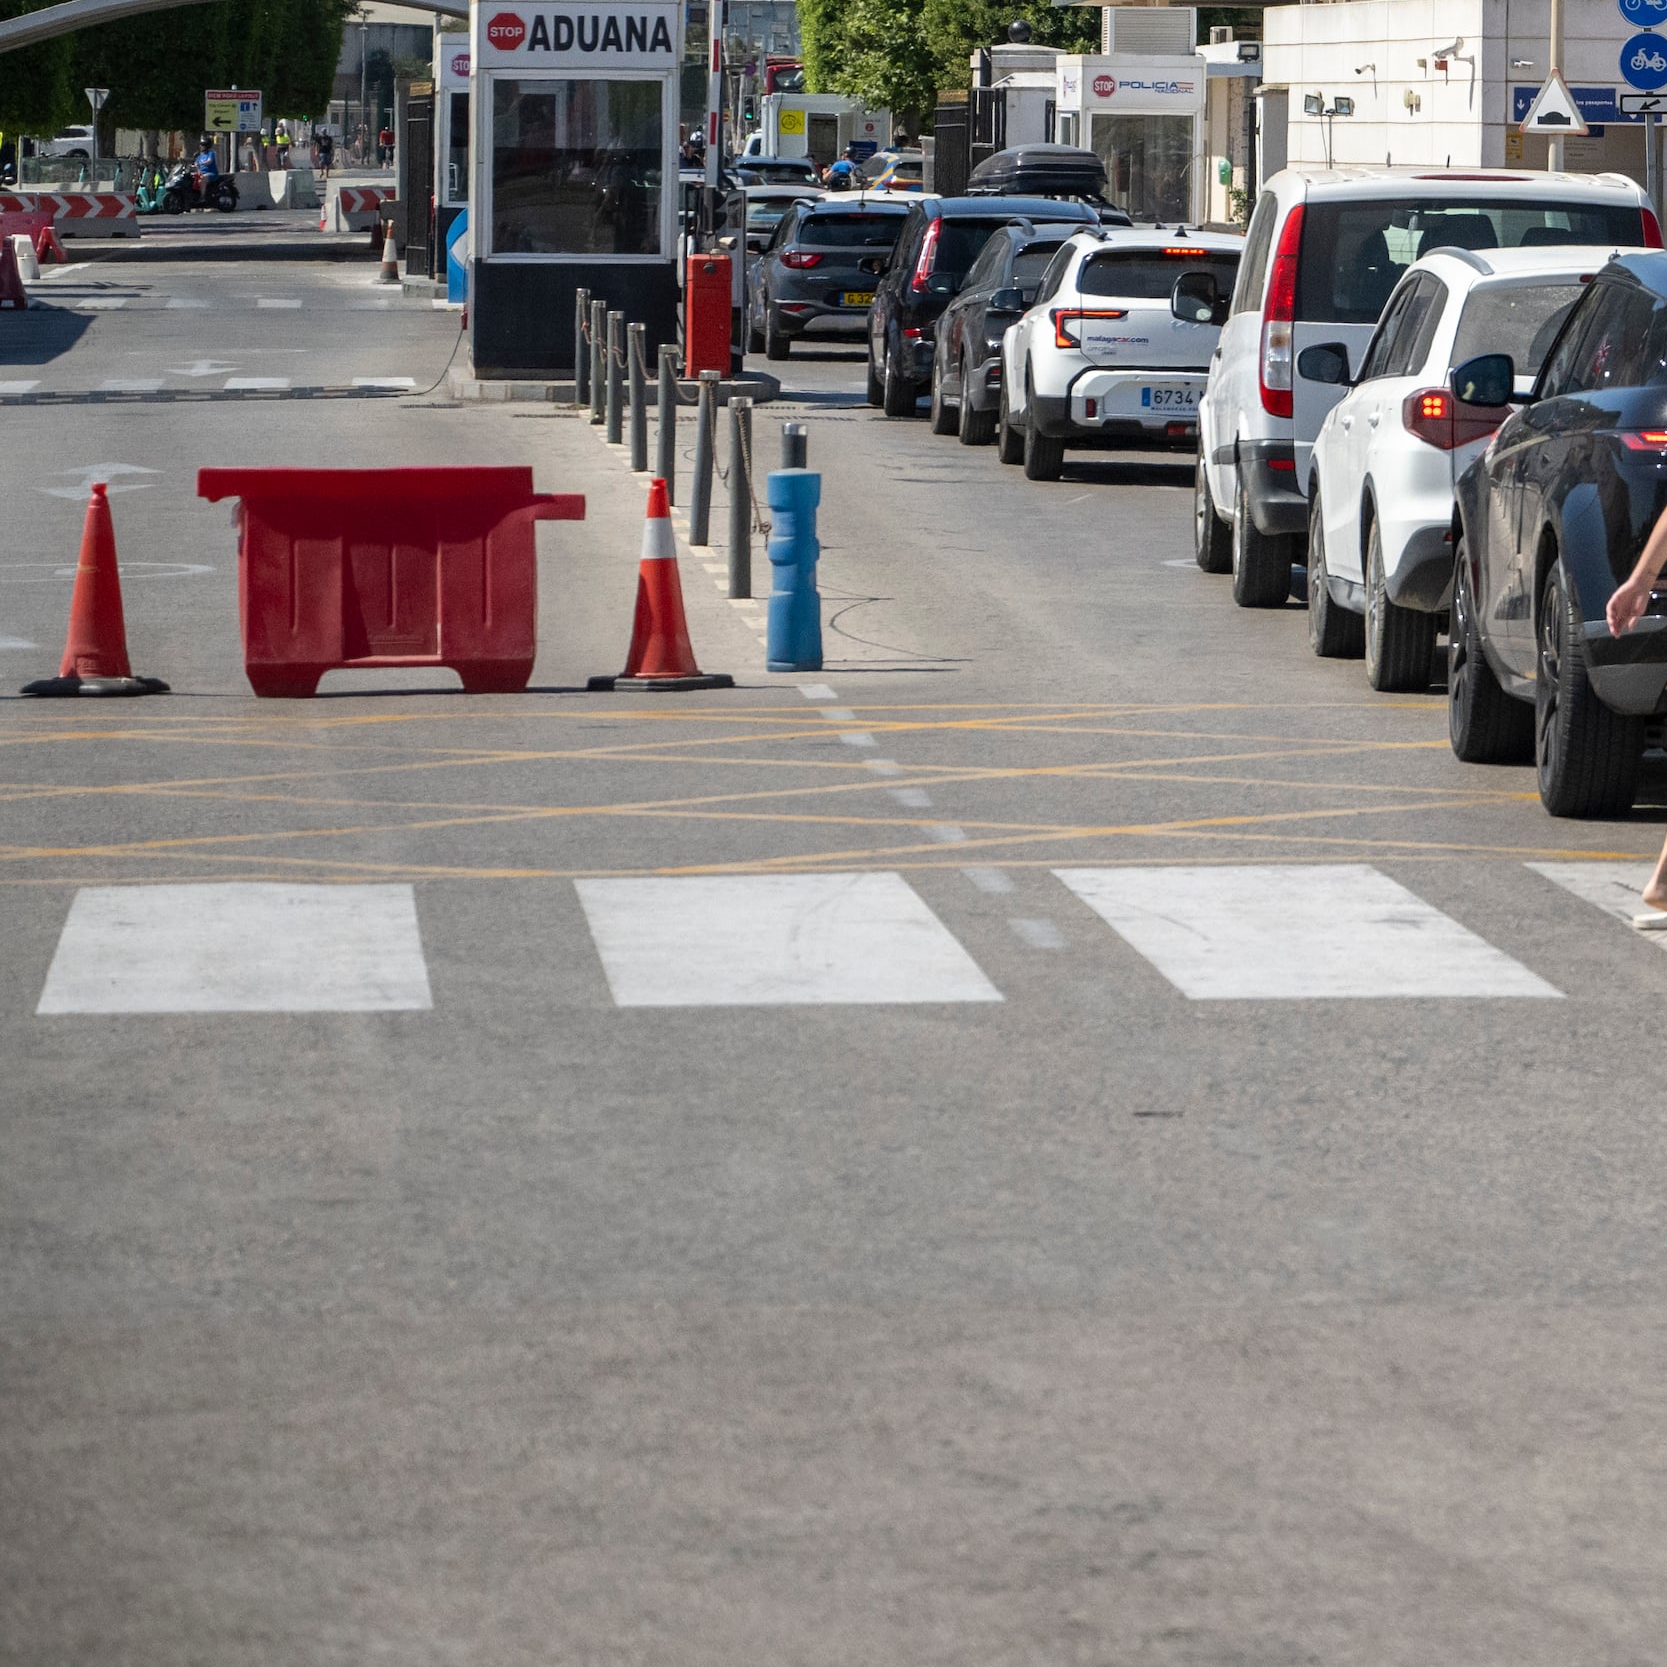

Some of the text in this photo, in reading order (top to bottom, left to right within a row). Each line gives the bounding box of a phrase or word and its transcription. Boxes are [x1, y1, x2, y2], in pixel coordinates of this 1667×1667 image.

[490, 26, 523, 38] STOP
[527, 15, 673, 53] ADUANA
[452, 60, 471, 71] STO
[1094, 80, 1114, 92] STOP
[1119, 81, 1179, 89] POLICIA
[857, 294, 874, 304] 32
[1086, 335, 1149, 345] malagacar.com
[1153, 390, 1193, 405] 6734
